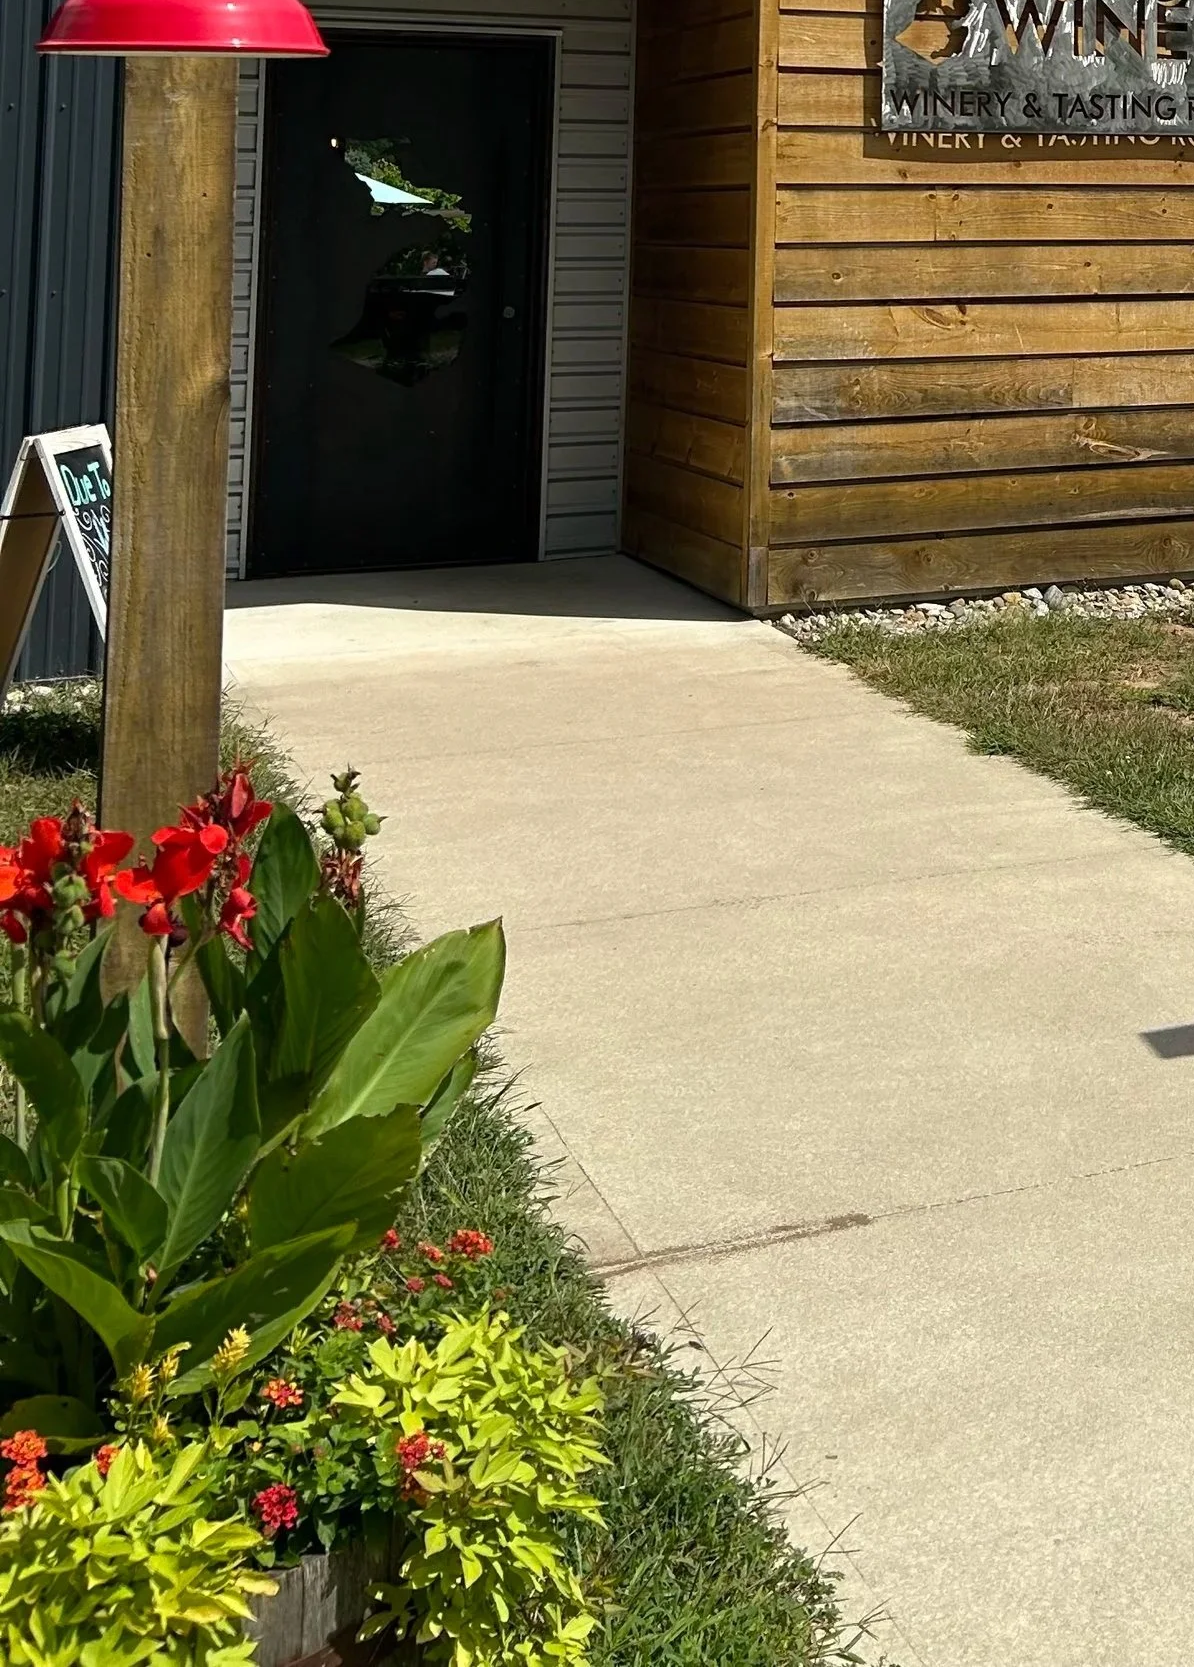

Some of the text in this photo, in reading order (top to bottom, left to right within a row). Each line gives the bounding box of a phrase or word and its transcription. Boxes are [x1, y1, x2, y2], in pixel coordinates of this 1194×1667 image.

[889, 89, 1013, 118] WINERY
[1022, 91, 1043, 119] &
[1052, 92, 1177, 121] TASTING
[60, 460, 112, 507] Due To
